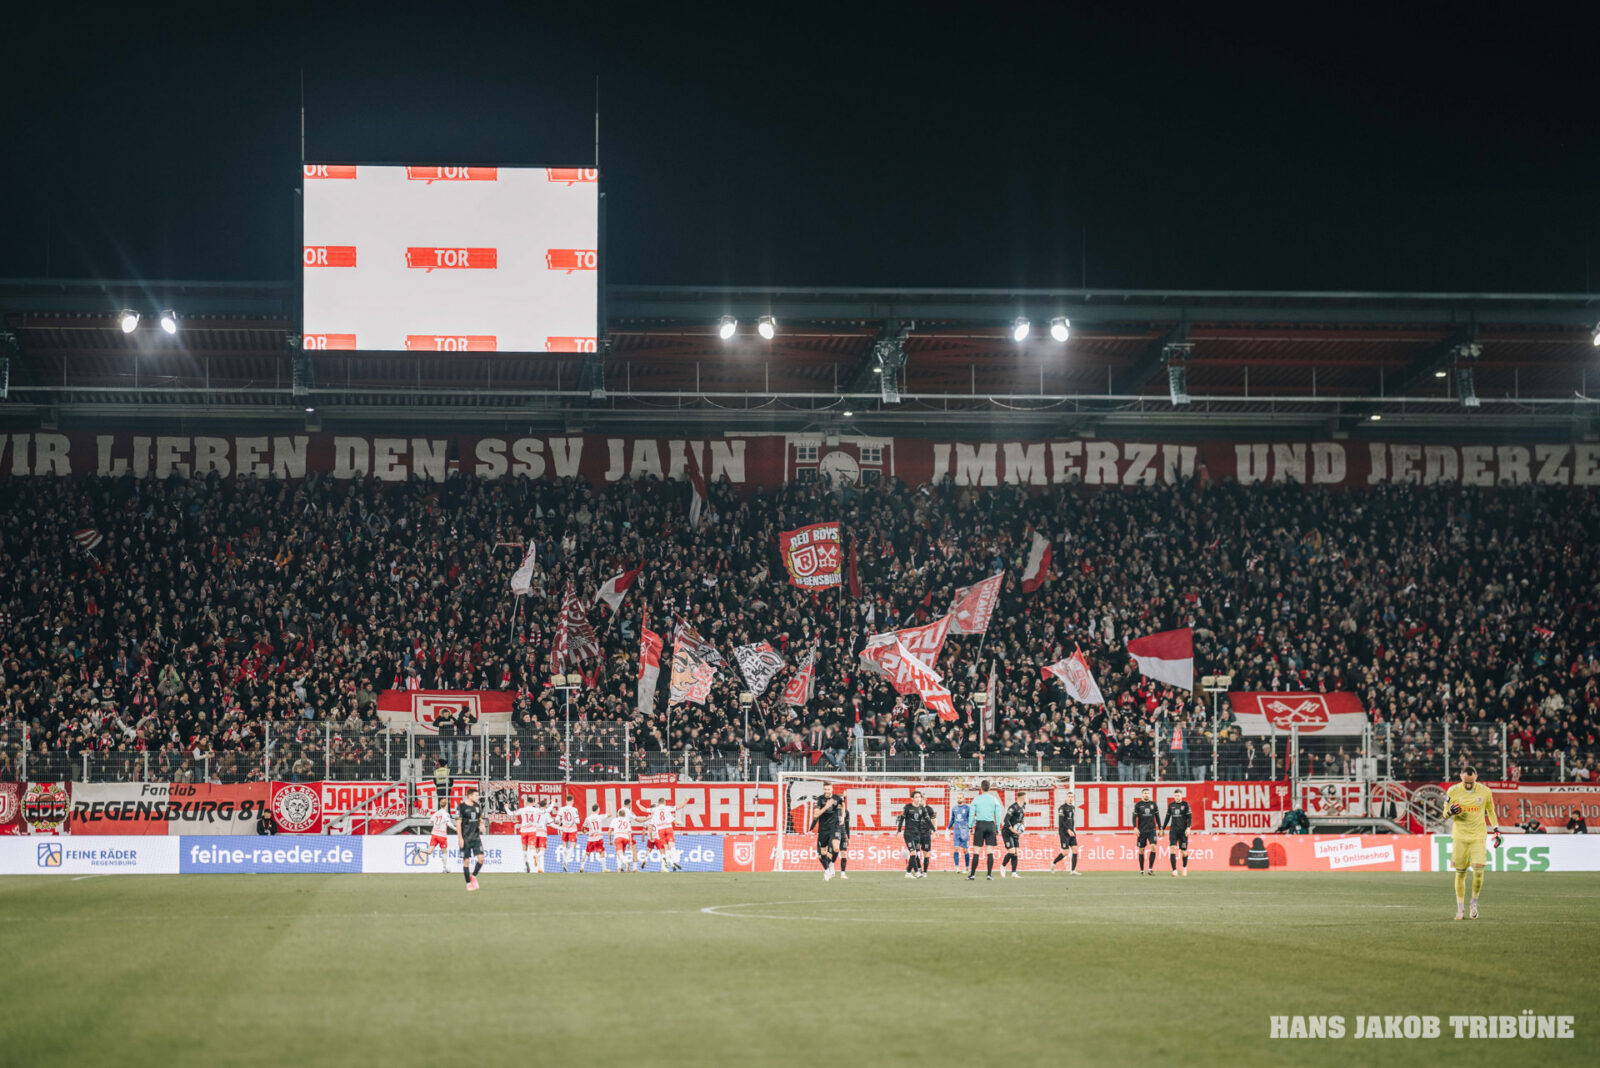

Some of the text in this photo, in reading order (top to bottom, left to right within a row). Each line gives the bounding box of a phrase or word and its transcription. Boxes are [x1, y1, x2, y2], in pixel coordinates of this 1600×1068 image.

[434, 250, 469, 267] TOR
[434, 338, 468, 351] TOR
[0, 433, 71, 477] IR
[333, 436, 447, 483] DEN
[475, 437, 583, 482] SSV
[1235, 442, 1347, 485] UND
[813, 527, 839, 542] BOYS
[141, 784, 196, 797] Fanclub
[520, 784, 537, 793] SSV
[539, 784, 562, 794] JAHN
[1212, 784, 1270, 809] JAHN
[72, 800, 266, 824] REGENSBURG 81
[847, 787, 1188, 828] REGESBURG
[525, 813, 534, 823] 14
[564, 811, 573, 821] 10
[660, 810, 665, 821] 8
[1212, 814, 1271, 828] STADION
[592, 821, 599, 831] 11
[618, 819, 628, 830] 29
[66, 847, 137, 860] FEINE RÄDER
[1339, 842, 1358, 852] Fan-
[190, 845, 354, 864] feine-raeder.de
[770, 846, 835, 864] Angeb
[1008, 847, 1054, 860] abatt
[1088, 846, 1115, 860] alle
[1342, 851, 1390, 864] Onlineshop
